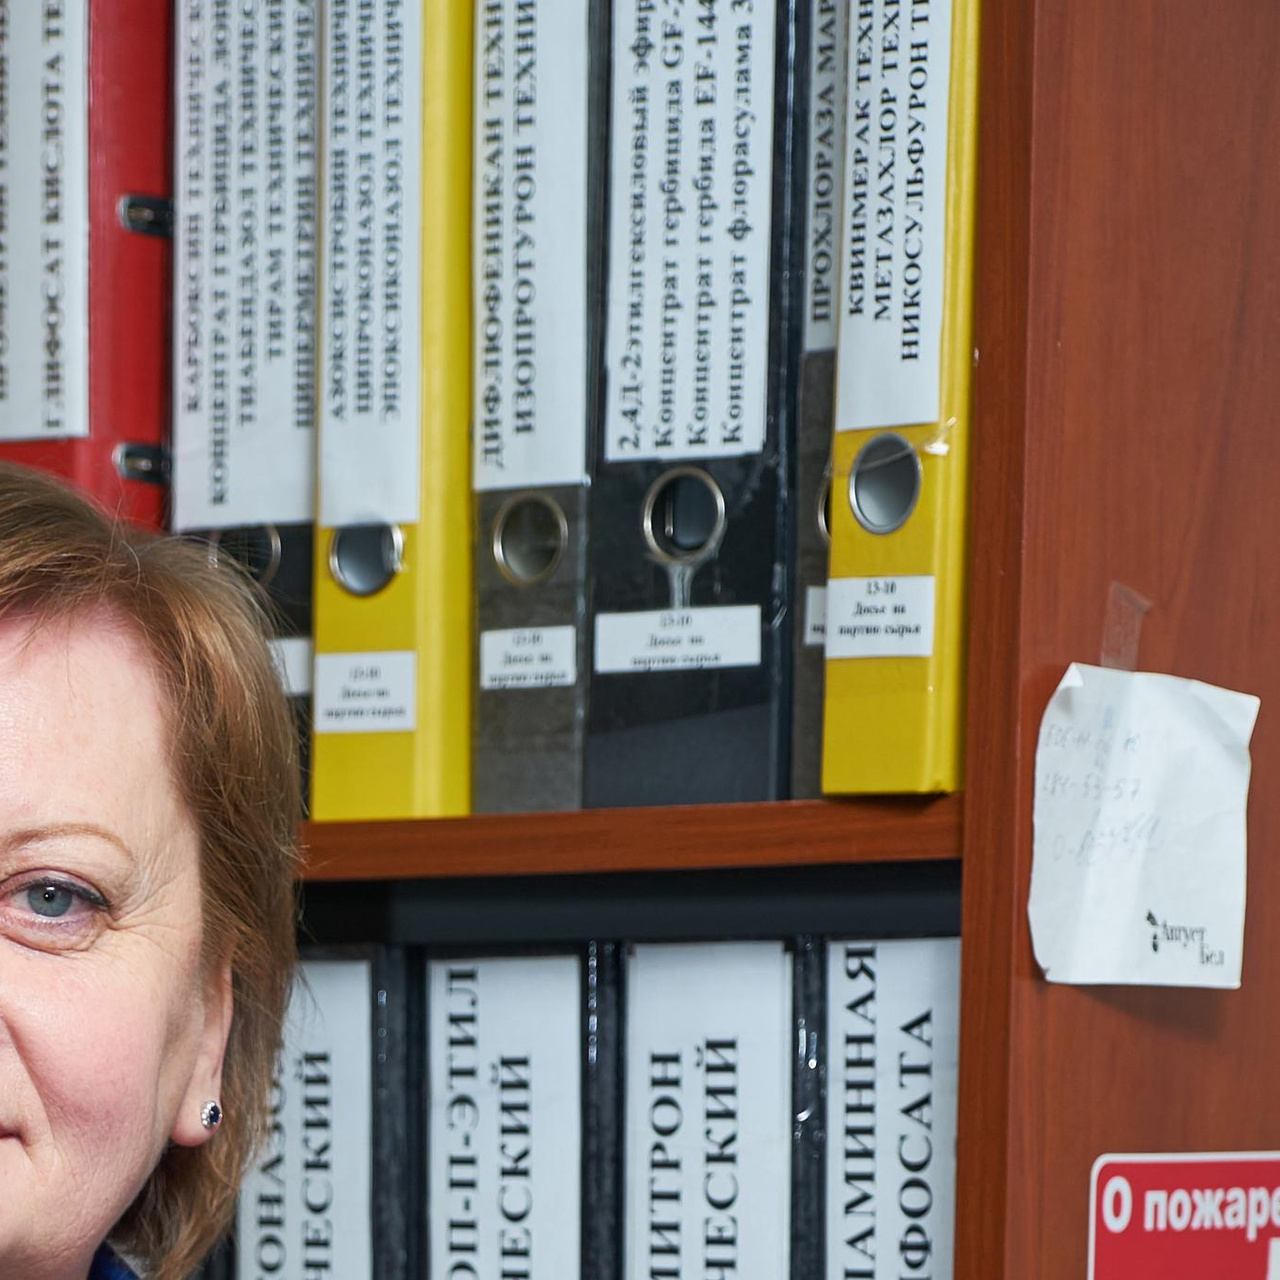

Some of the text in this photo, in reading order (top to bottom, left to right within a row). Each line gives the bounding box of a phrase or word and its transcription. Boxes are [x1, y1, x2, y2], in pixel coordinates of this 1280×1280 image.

[43, 53, 65, 224] КИСЛОТА
[211, 80, 232, 275] ГЕРБИЦИДА
[294, 0, 315, 428] ЦИПЕРМЕТРИН ТЕХНИЧЕ
[659, 81, 684, 246] гербицида
[726, 25, 756, 241] флорасулама
[810, 84, 836, 322] ПРОХЛОРАЗА
[849, 101, 871, 316] КВИНМЕРАК
[874, 88, 898, 322] МЕТАЗАХЛОР
[901, 42, 929, 360] НИКОСУЛЬФУРОН
[42, 238, 65, 428] ГЛИФОСАТ
[238, 187, 259, 425] ТИАБЕНДАЗОЛ
[266, 248, 285, 360] ТИРАМ
[483, 119, 505, 469] ДИФЛЮФЕНИКАН
[513, 145, 536, 435] ИЗОПРОТУРОН
[654, 258, 682, 448] Концентрат
[688, 257, 715, 446] Концентрат
[722, 255, 748, 444] Концентрат
[209, 291, 230, 507] КОНЦЕНТРАТ
[1102, 1176, 1132, 1233] О
